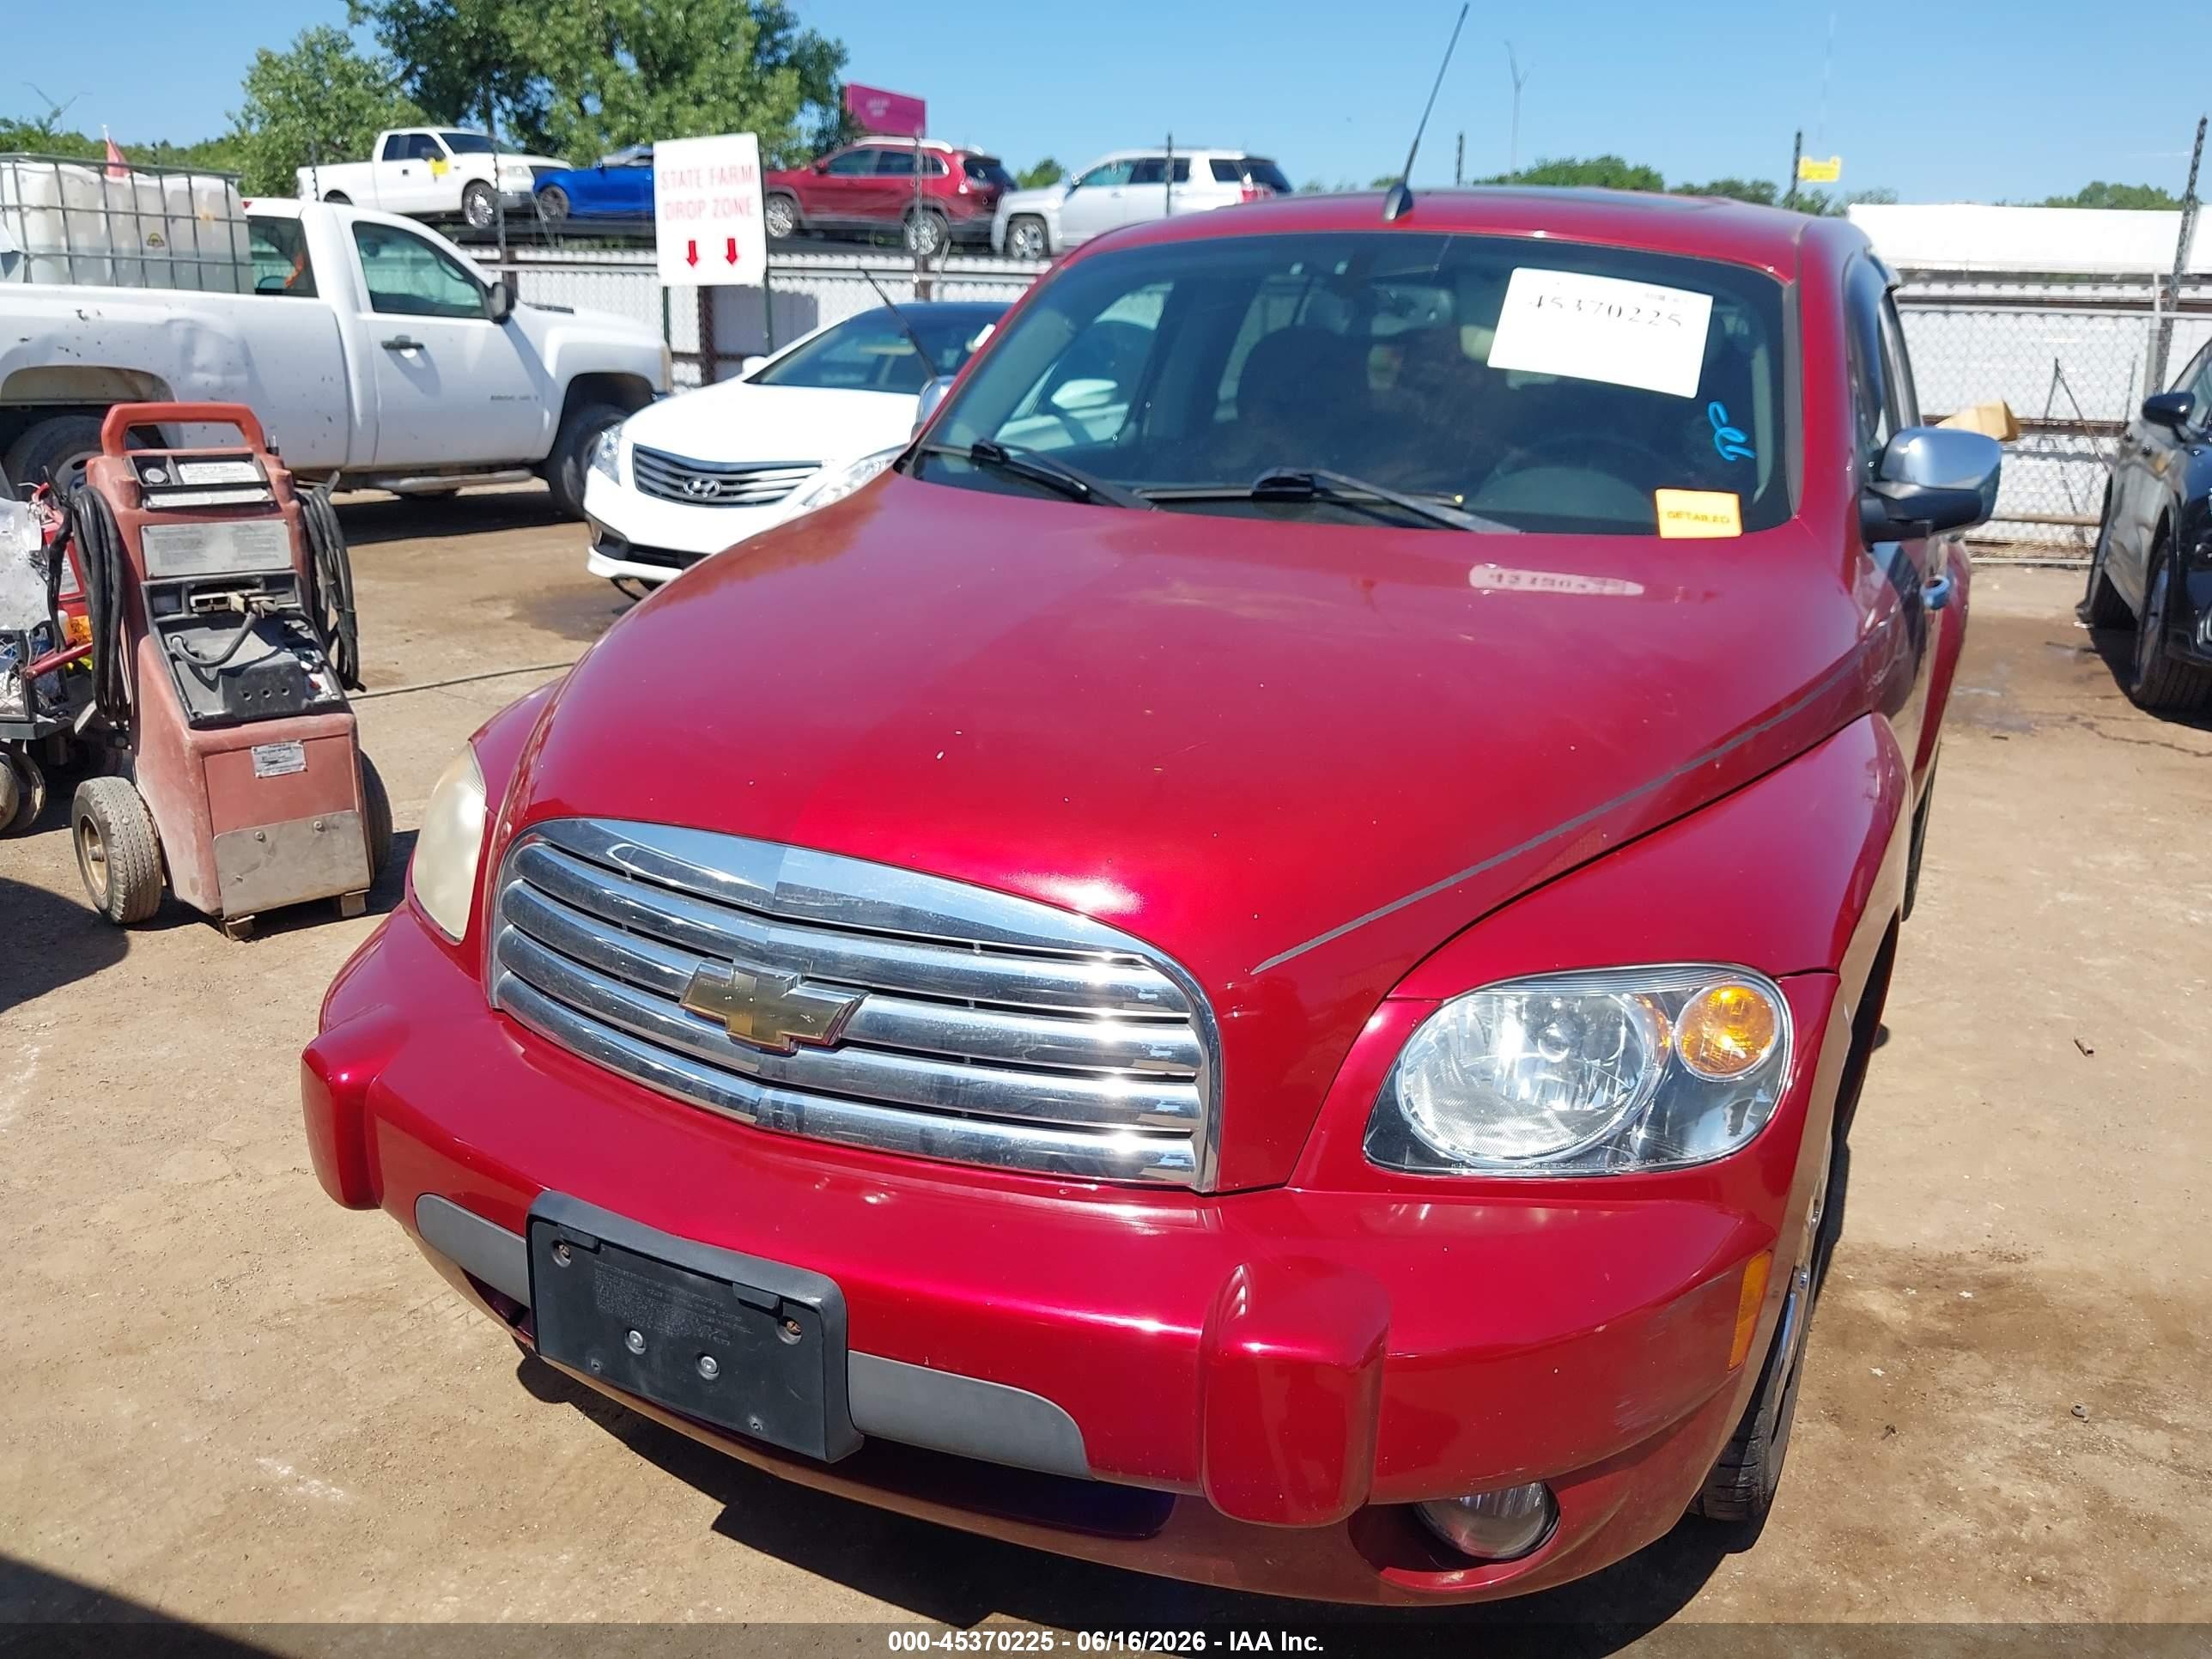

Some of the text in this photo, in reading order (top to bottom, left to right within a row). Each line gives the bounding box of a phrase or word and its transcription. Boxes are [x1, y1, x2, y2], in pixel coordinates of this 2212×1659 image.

[660, 164, 756, 191] STATE FARM
[665, 196, 756, 222] DROP ZONE
